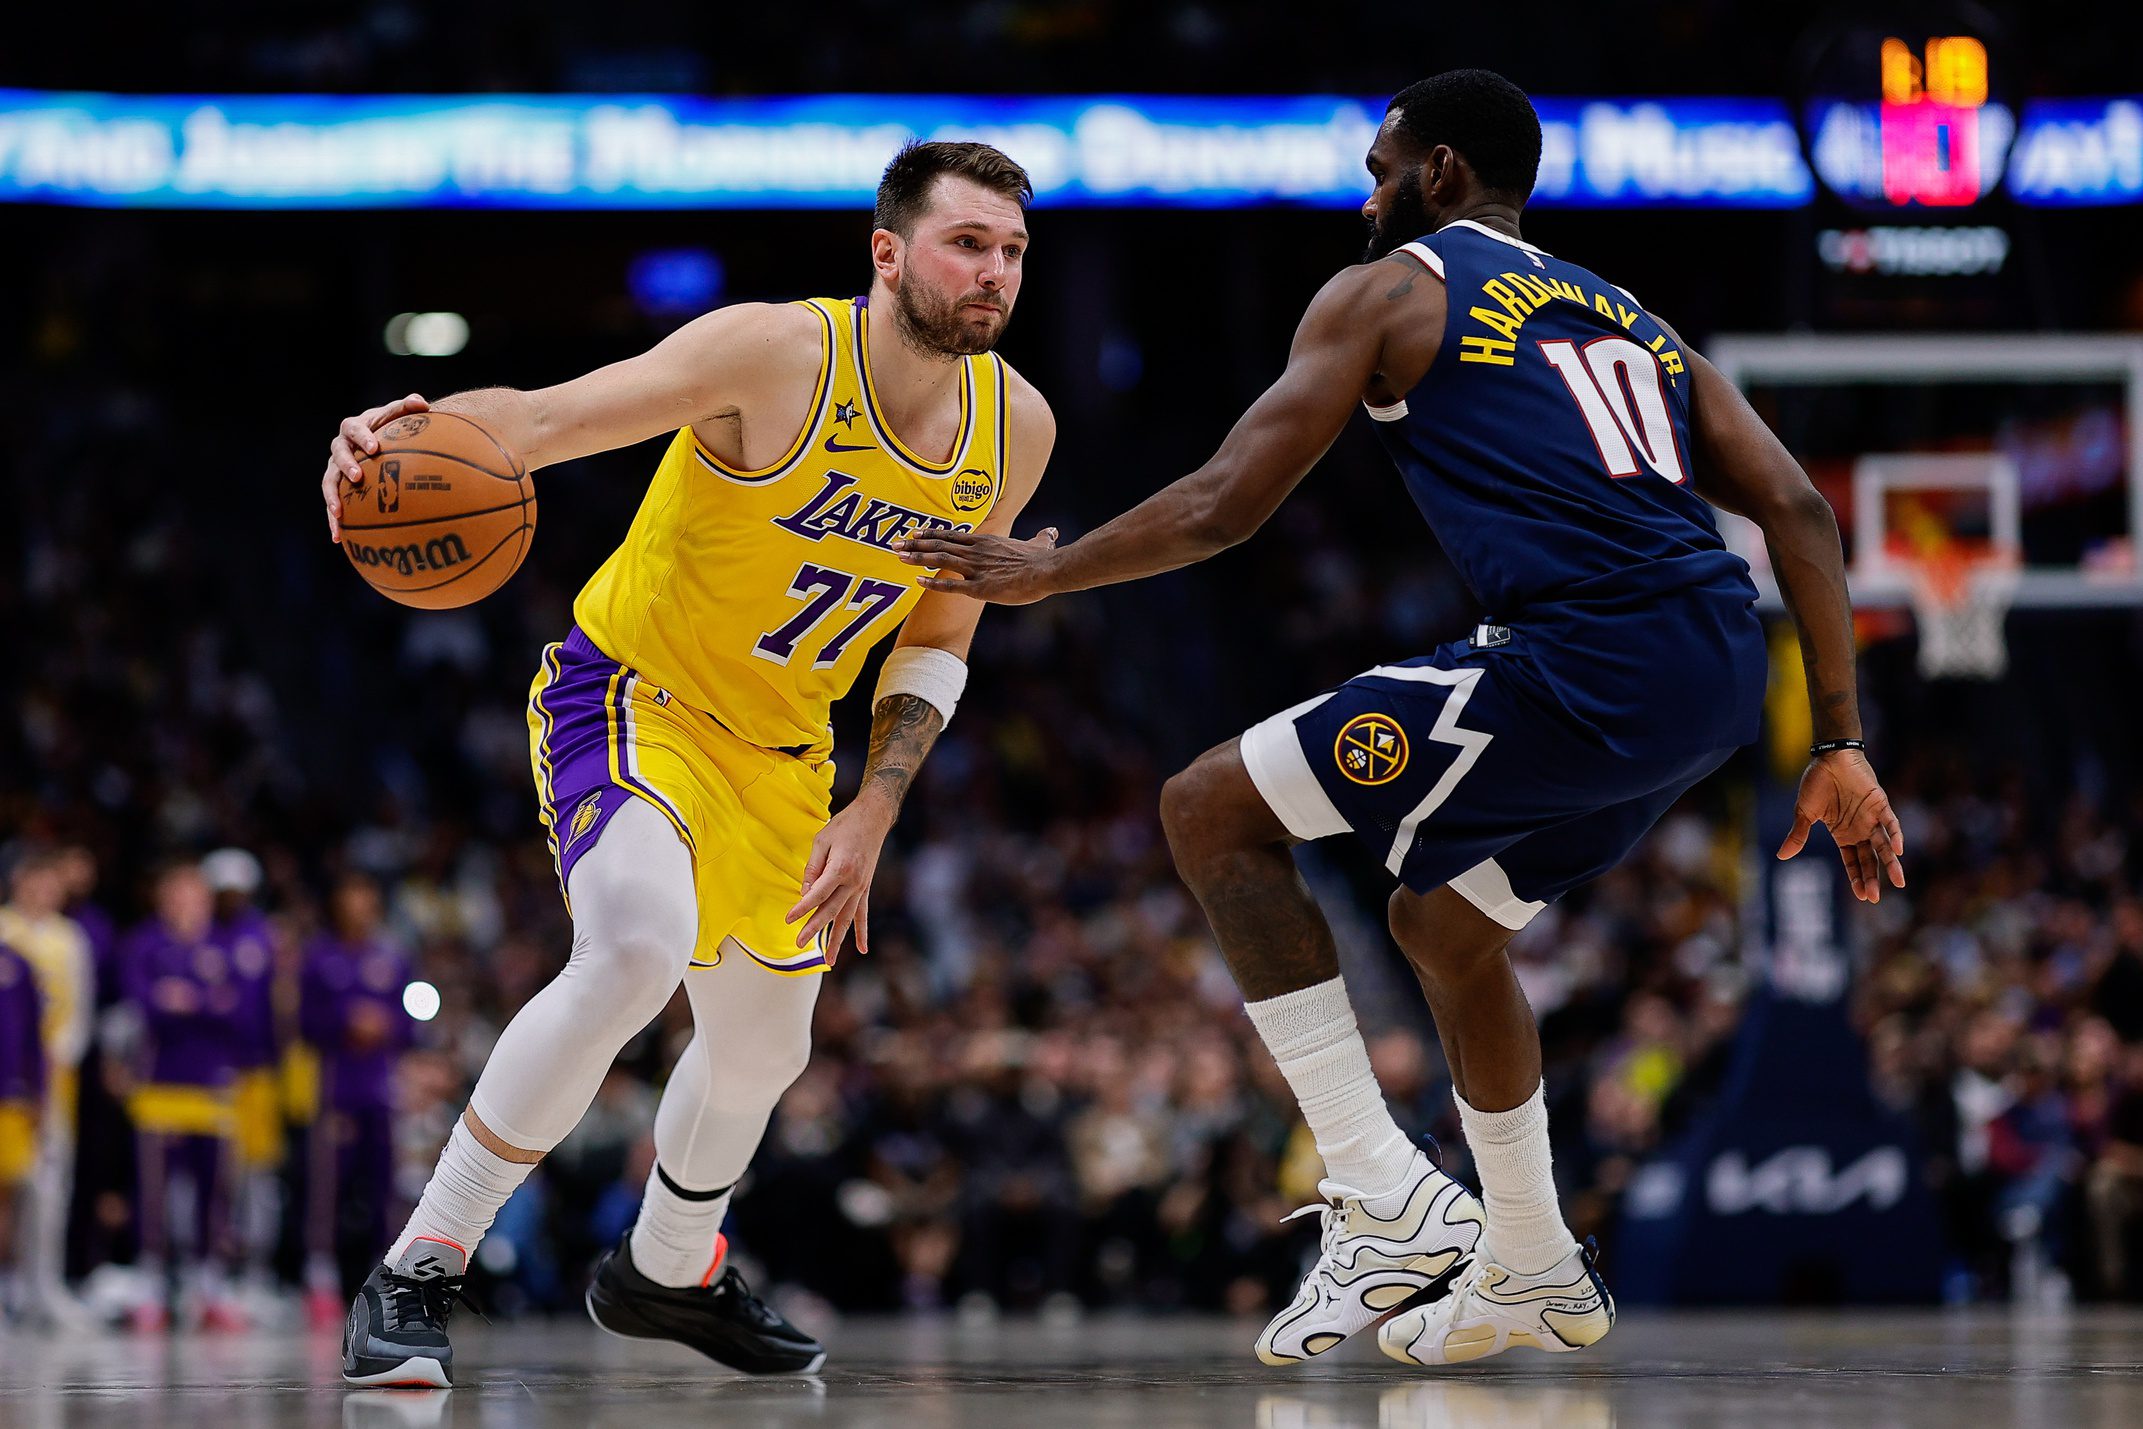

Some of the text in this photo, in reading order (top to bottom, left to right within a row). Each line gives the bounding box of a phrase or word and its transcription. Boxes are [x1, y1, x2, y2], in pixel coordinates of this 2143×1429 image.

[1536, 335, 1688, 485] 10
[770, 469, 974, 571] LAKE
[954, 480, 990, 500] bibigo
[347, 533, 472, 577] Wilson
[751, 561, 912, 672] 77
